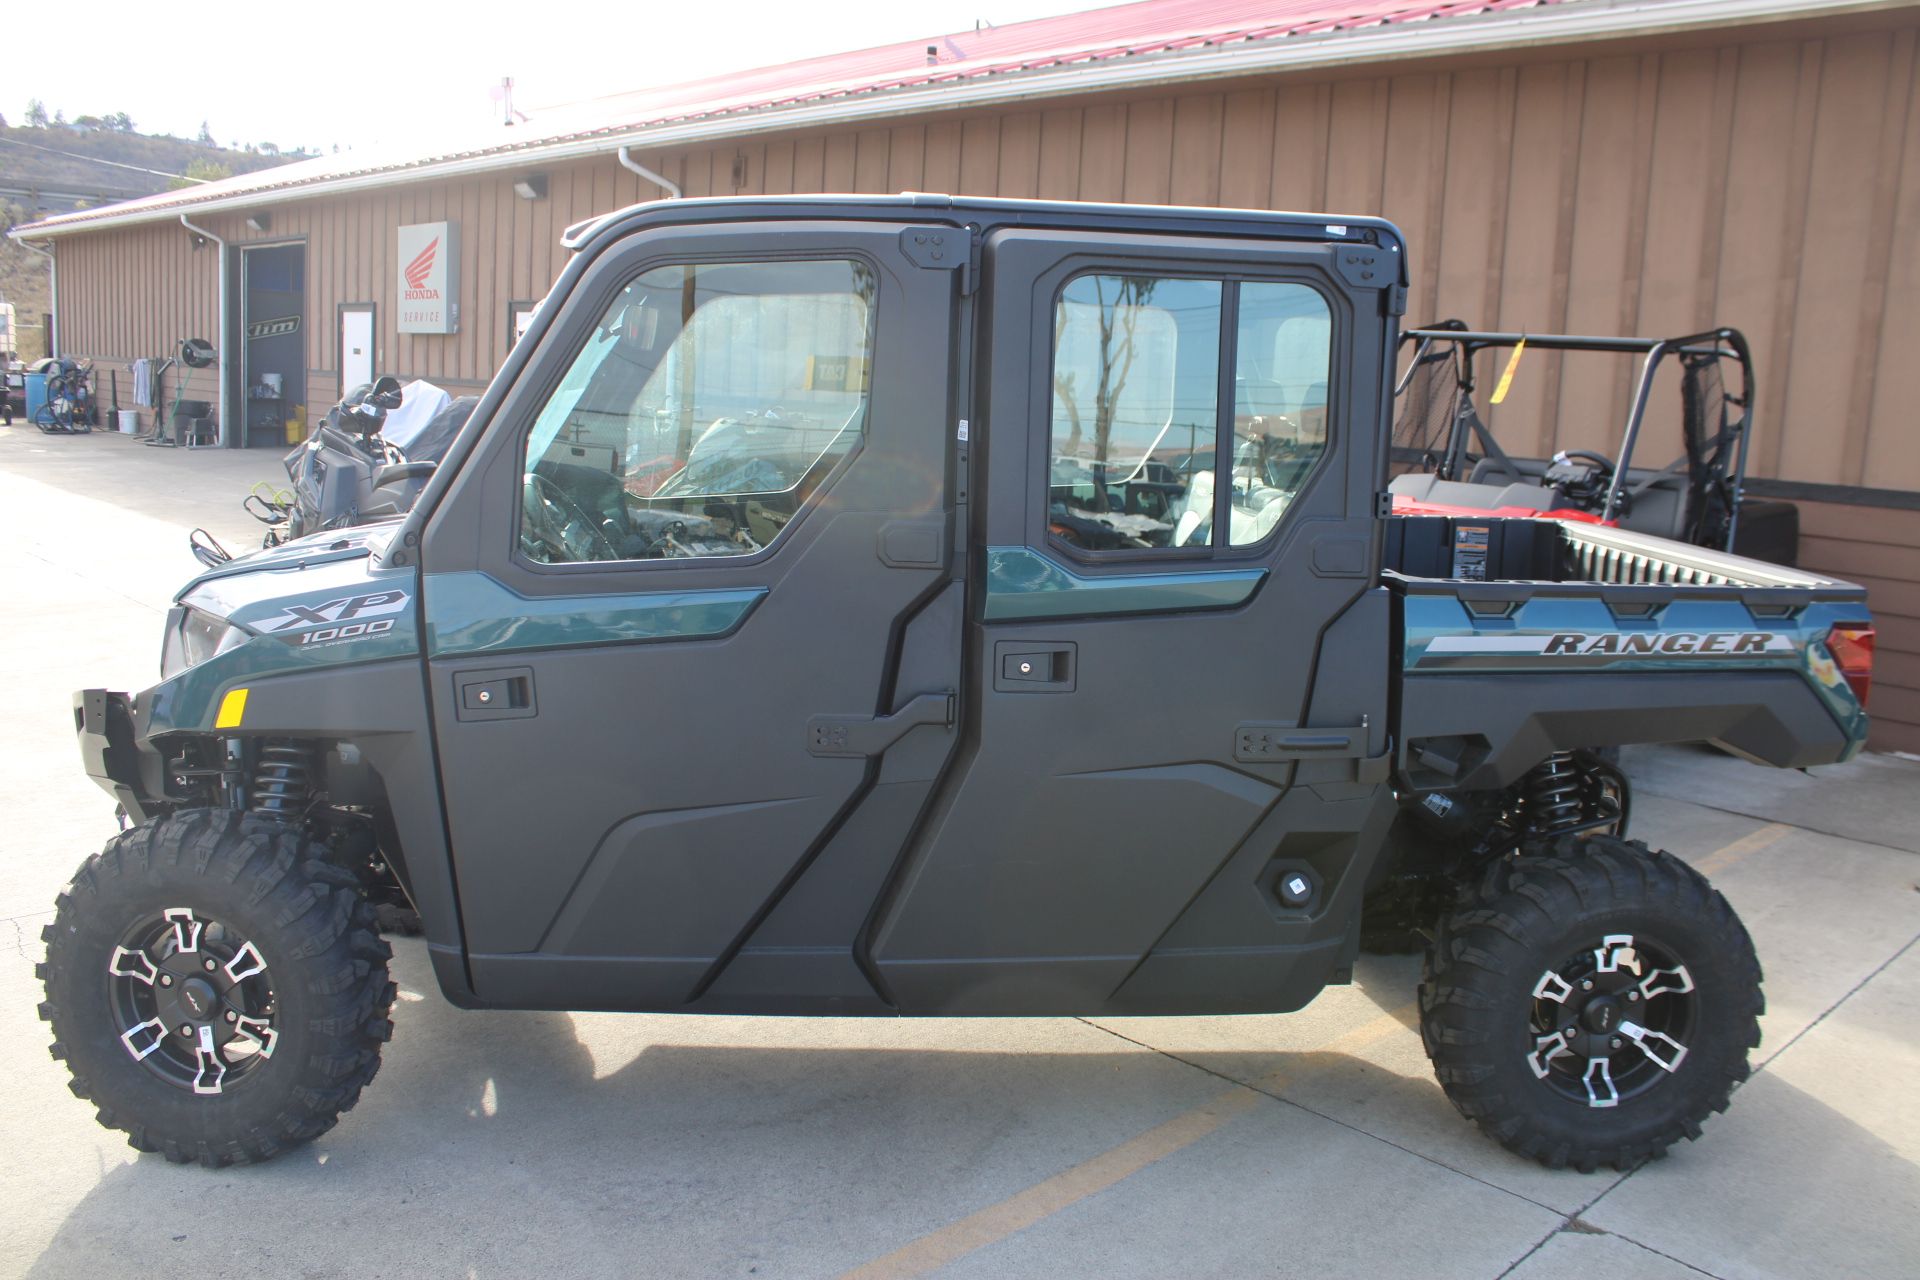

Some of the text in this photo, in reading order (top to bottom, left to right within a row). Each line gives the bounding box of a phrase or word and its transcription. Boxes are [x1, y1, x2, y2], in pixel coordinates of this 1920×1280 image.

[405, 289, 440, 301] HONDA
[404, 311, 440, 322] SERVICE
[269, 589, 406, 632] XP
[302, 619, 395, 644] 1000
[1540, 632, 1776, 656] RANGER
